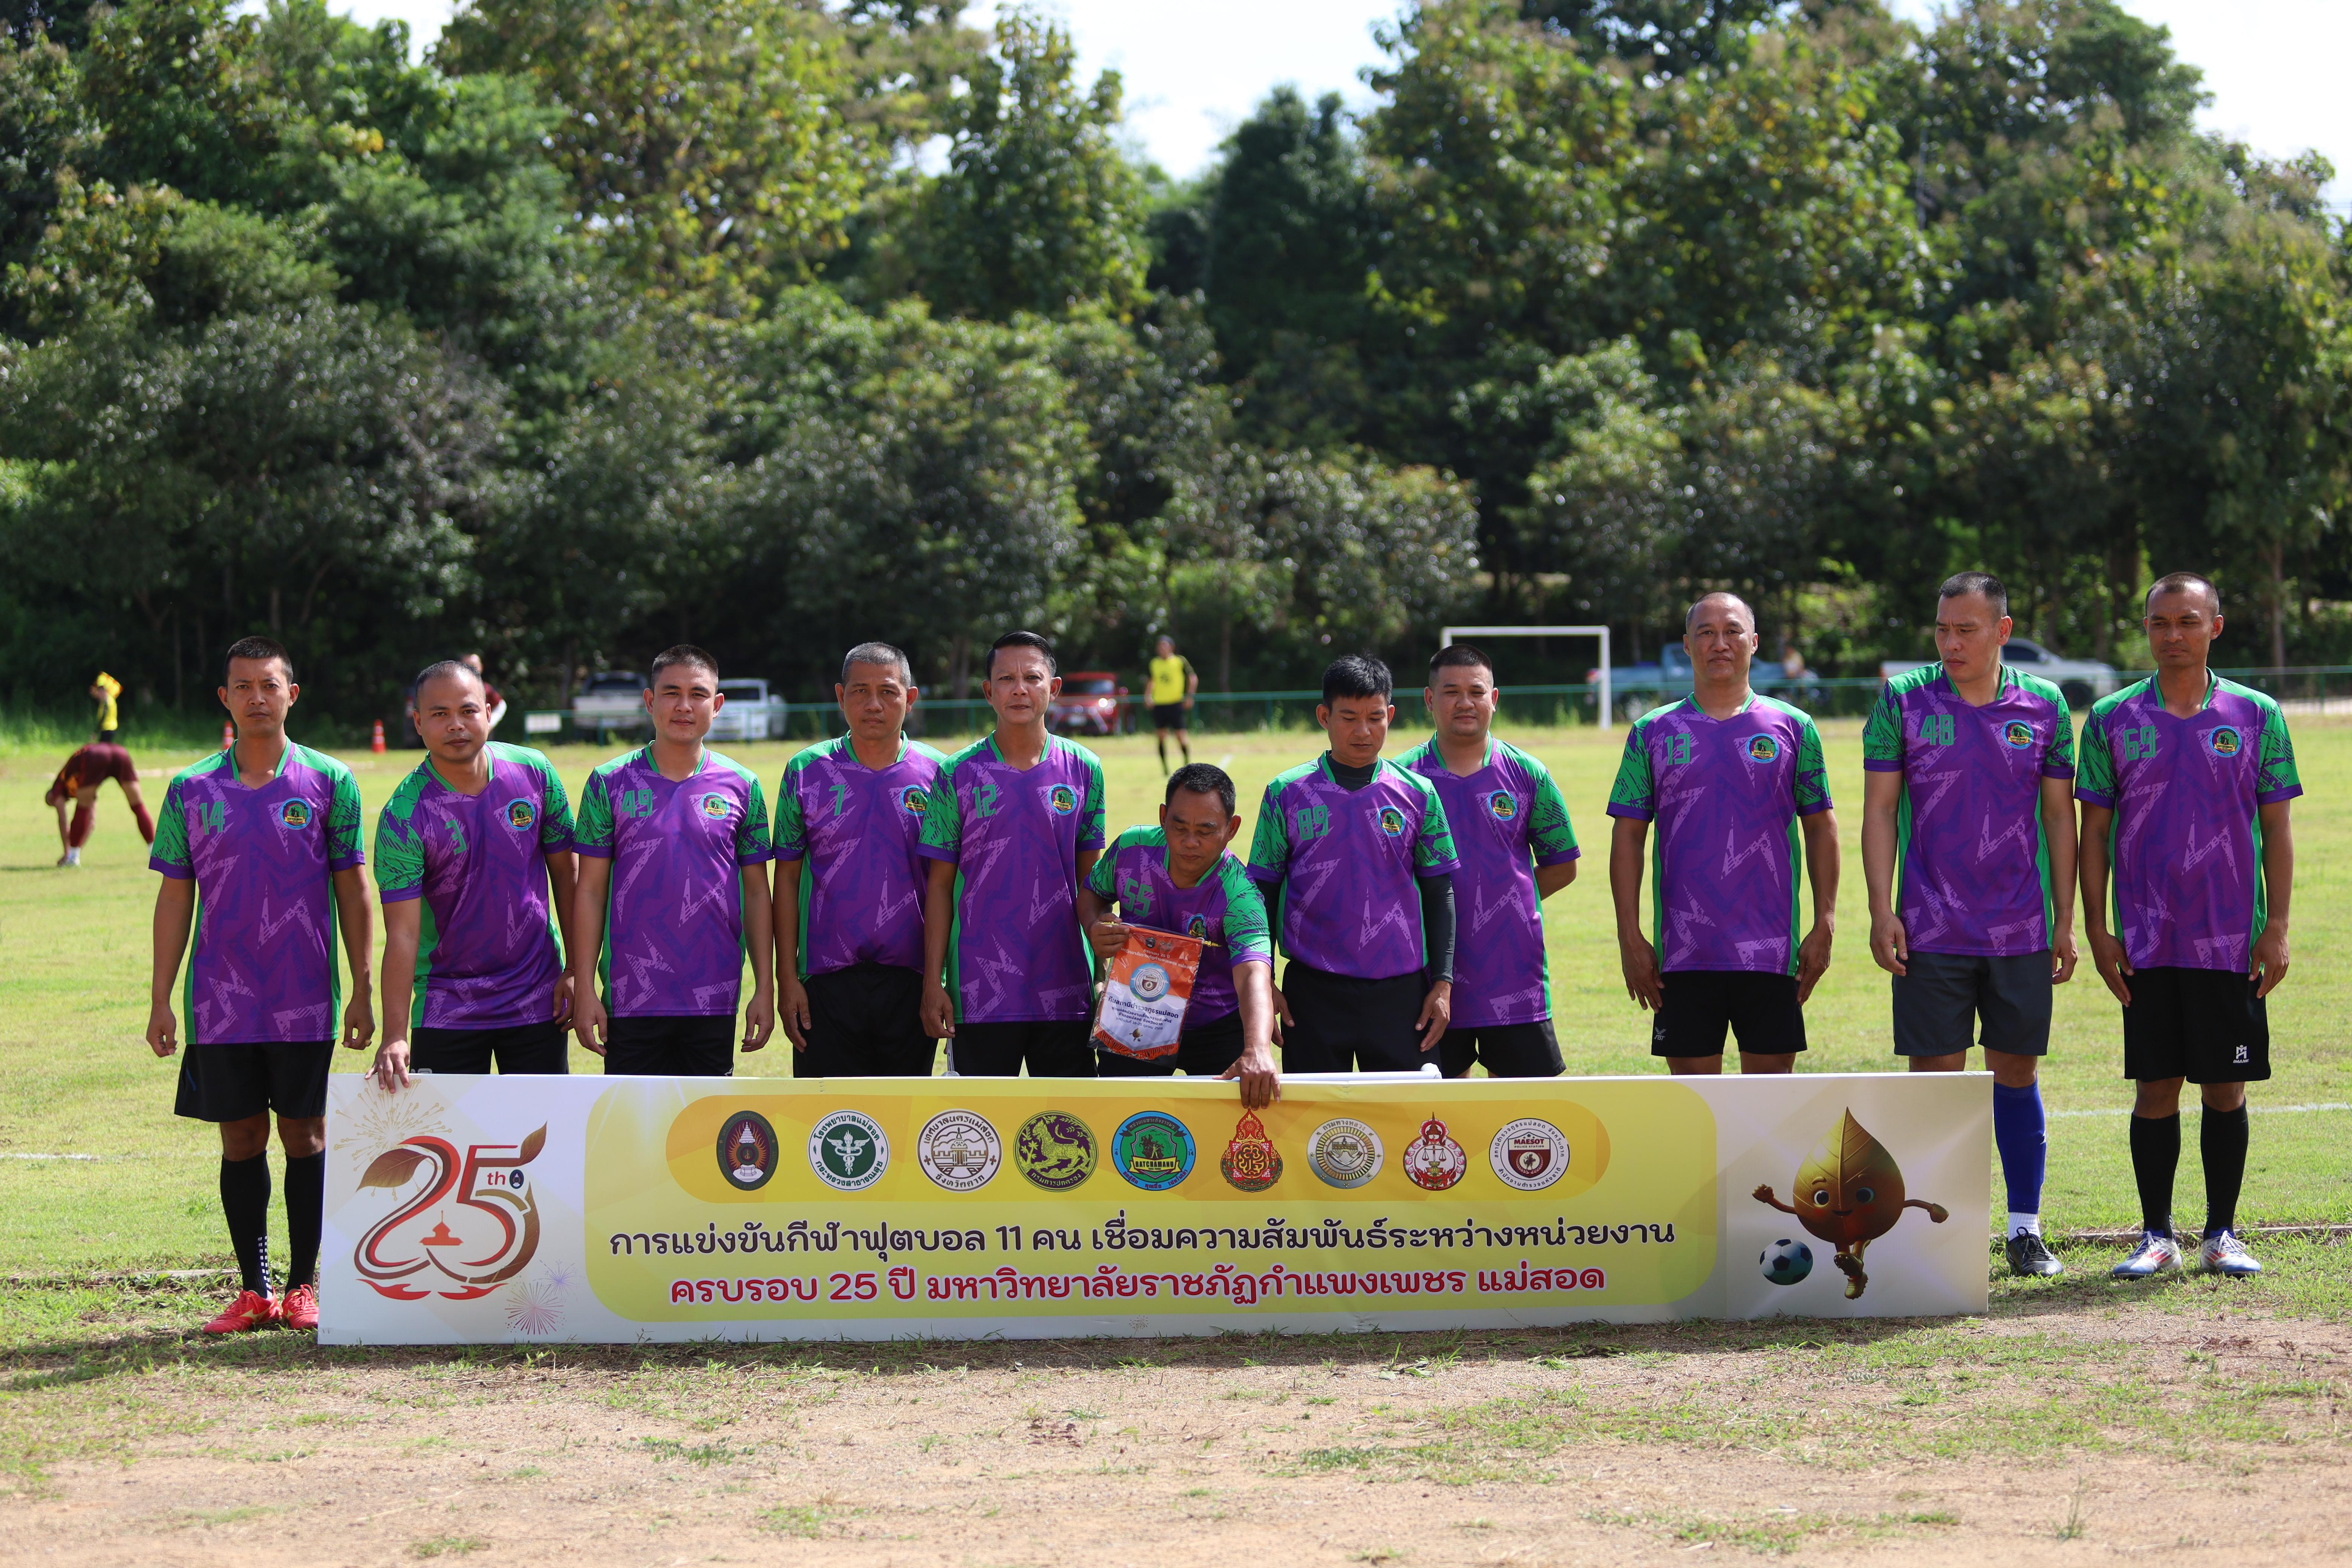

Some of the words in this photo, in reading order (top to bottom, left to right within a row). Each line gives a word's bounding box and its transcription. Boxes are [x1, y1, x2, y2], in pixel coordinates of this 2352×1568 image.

[1921, 714, 1954, 746] 48
[2123, 725, 2156, 761] 69
[1664, 733, 1690, 766] 13
[621, 789, 653, 818] 49
[829, 784, 845, 816] 7
[972, 784, 997, 818] 12
[199, 802, 225, 835] 14
[1297, 805, 1329, 841] 89
[445, 820, 467, 855] 3
[1123, 877, 1153, 917] 55
[813, 1115, 880, 1141] โรงพยาบาลแม่สอด
[924, 1115, 995, 1144] เทศบาลนครแม่สอด
[486, 1171, 506, 1185] th
[815, 1161, 883, 1187] กระทรวงสาธารณสุข
[609, 1220, 985, 1263] การแข่งขันกีฬาฟุตบอล
[995, 1225, 1021, 1251] 11
[1032, 1229, 1082, 1251] คน
[1092, 1209, 1675, 1250] เชื่อมความสัมพันธ์ระหว่างหน่วยงาน
[671, 1277, 818, 1303] ครบรอบ
[830, 1273, 877, 1300] 25
[888, 1266, 916, 1300] ปี
[927, 1264, 1467, 1305] มหาวิทยาลัยราชภัฏกำแพงเพชร
[1479, 1261, 1604, 1292] แม่สอด
